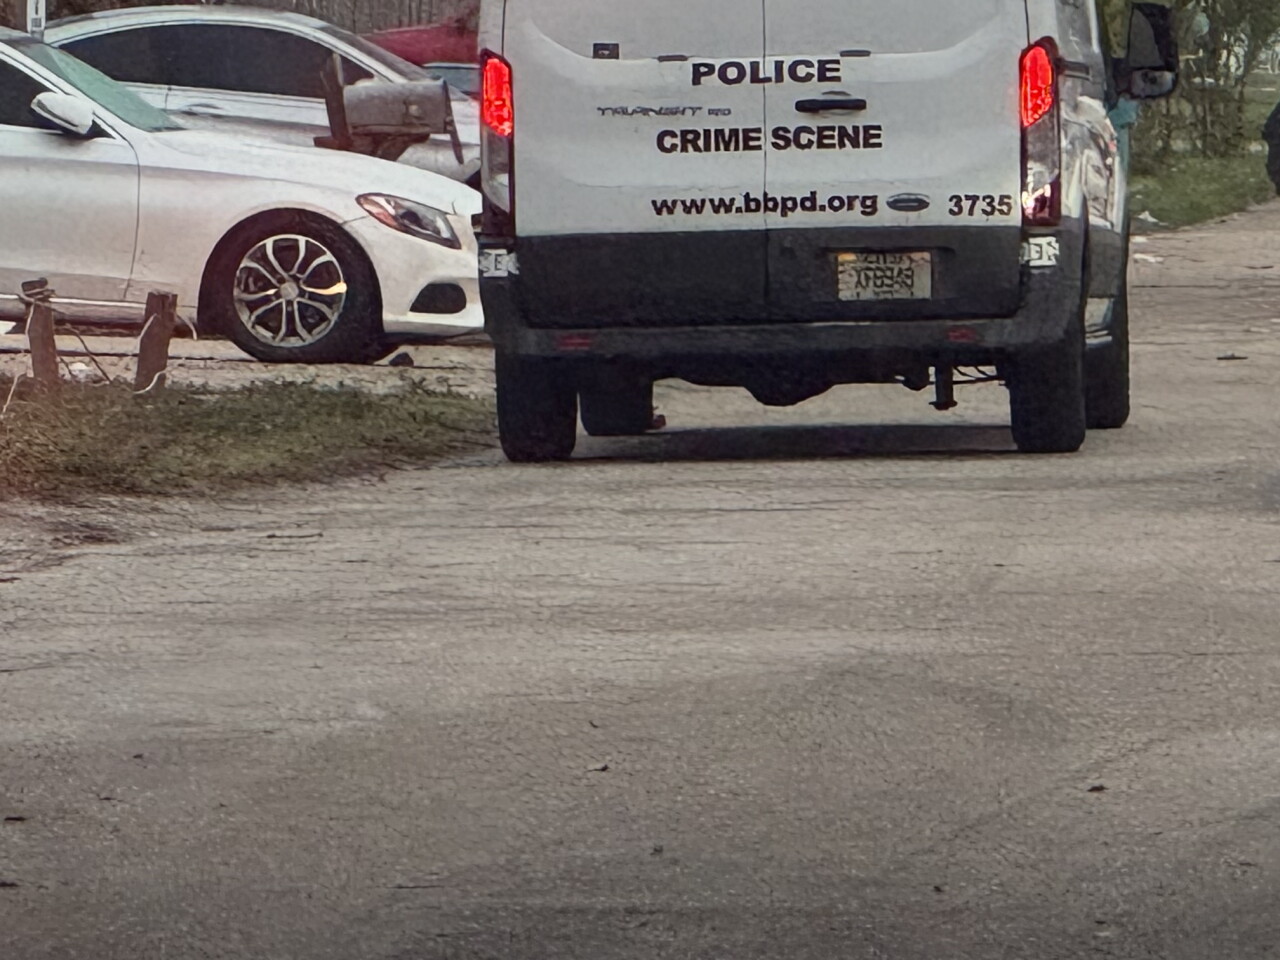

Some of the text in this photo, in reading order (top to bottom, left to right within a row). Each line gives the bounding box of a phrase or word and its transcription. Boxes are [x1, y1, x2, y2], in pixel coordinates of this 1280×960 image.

[691, 59, 842, 86] POLICE
[656, 124, 883, 153] CRIME SCENE
[651, 190, 879, 218] www.bbpd.org
[948, 194, 1013, 217] 3735
